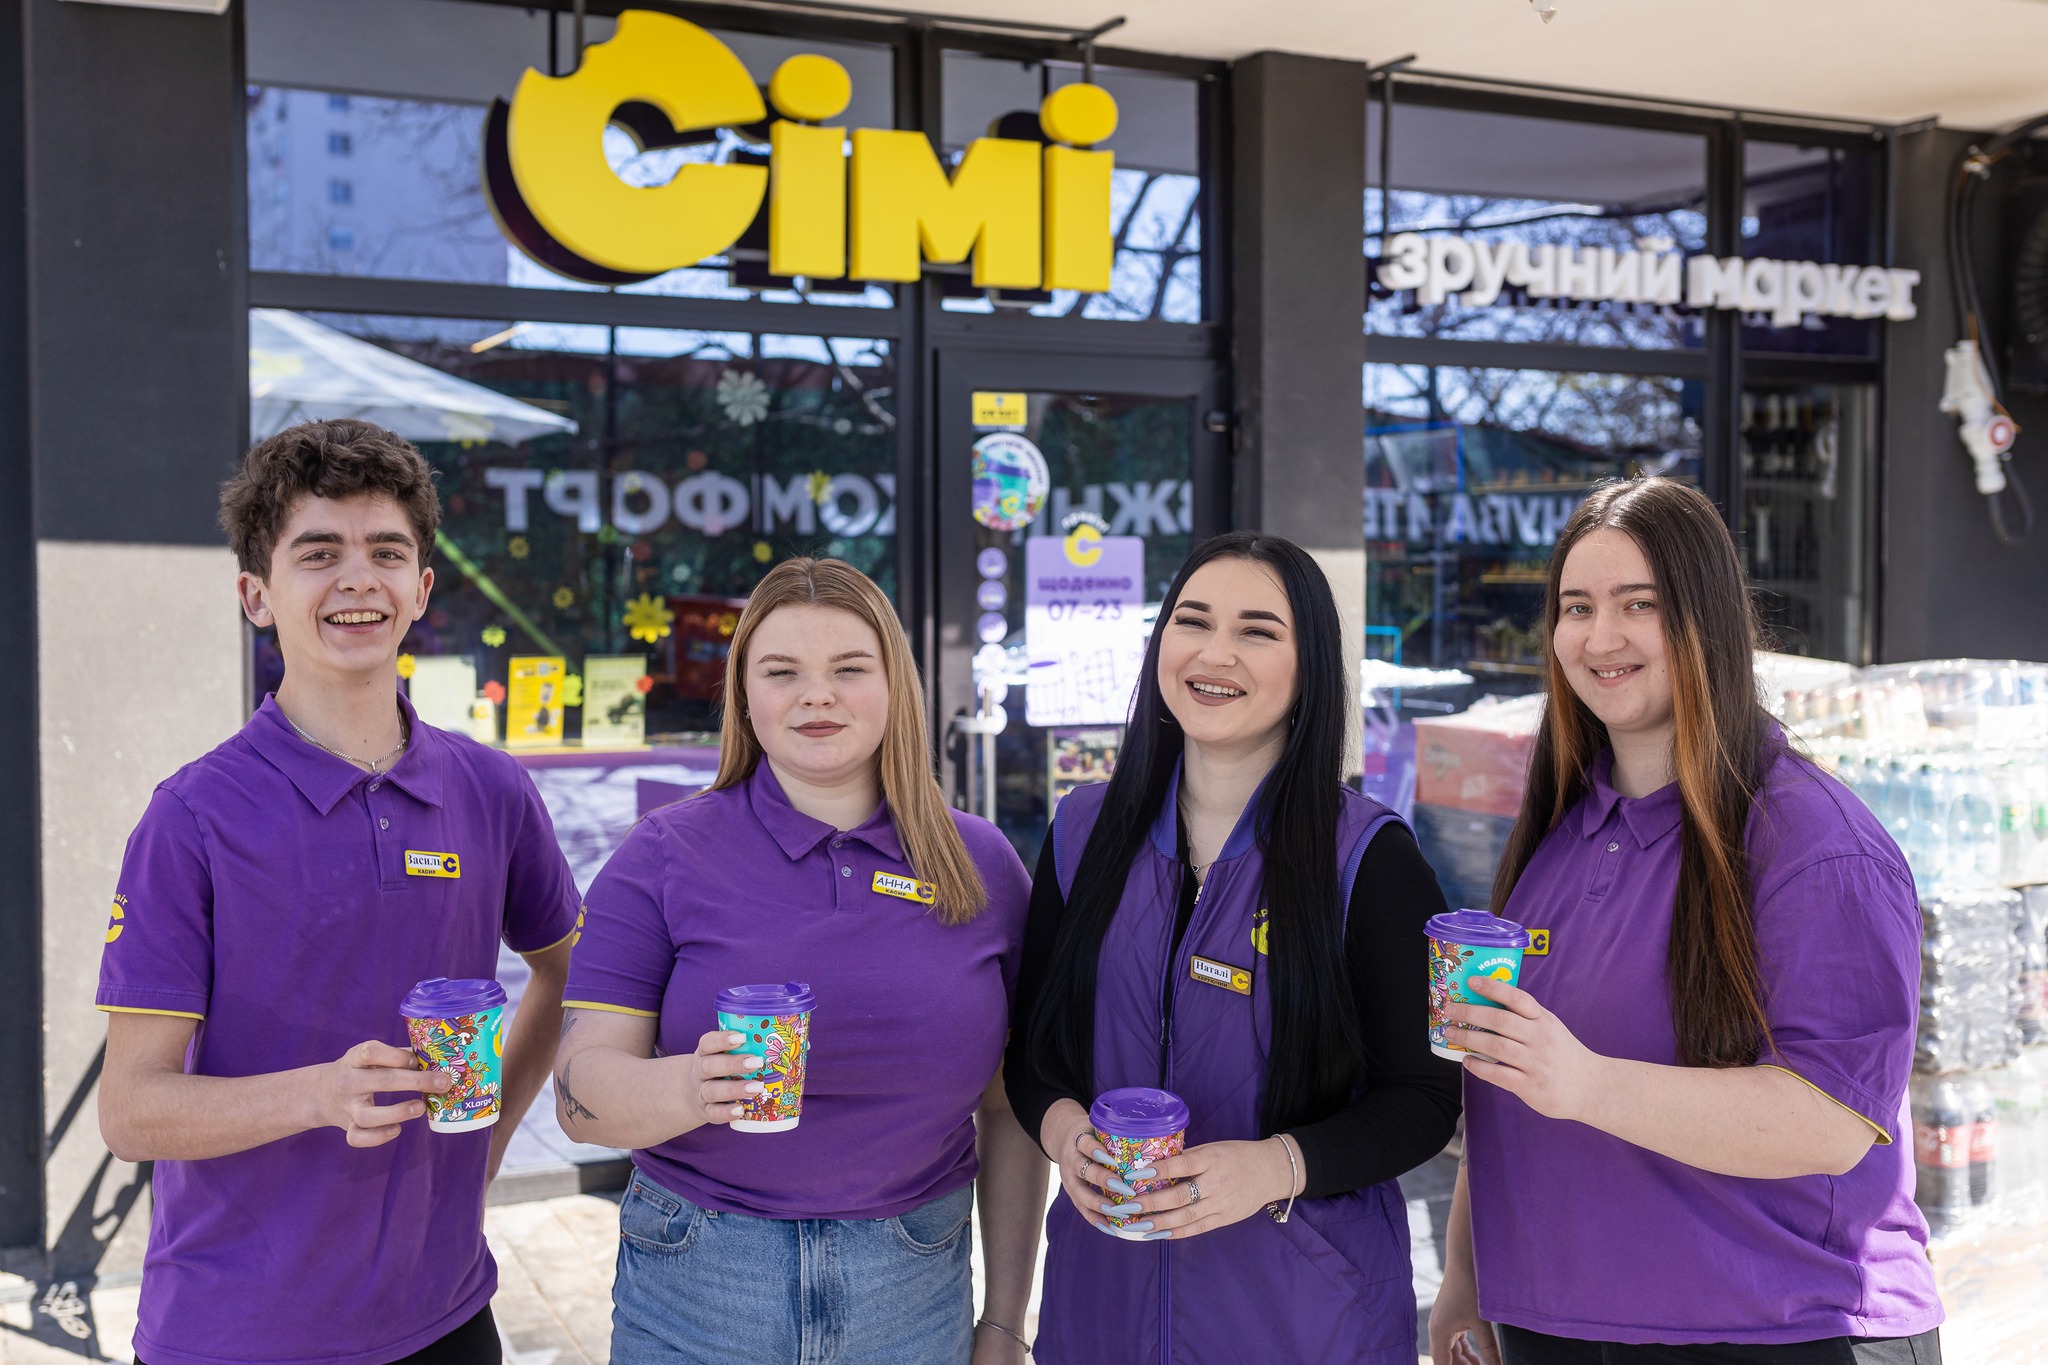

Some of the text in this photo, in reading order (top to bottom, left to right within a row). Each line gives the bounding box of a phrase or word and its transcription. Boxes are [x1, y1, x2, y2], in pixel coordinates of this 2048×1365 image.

[1379, 231, 1920, 328] зручний маркет
[876, 877, 912, 891] АННА
[1196, 960, 1229, 978] Наталі
[465, 1098, 492, 1109] XLarge
